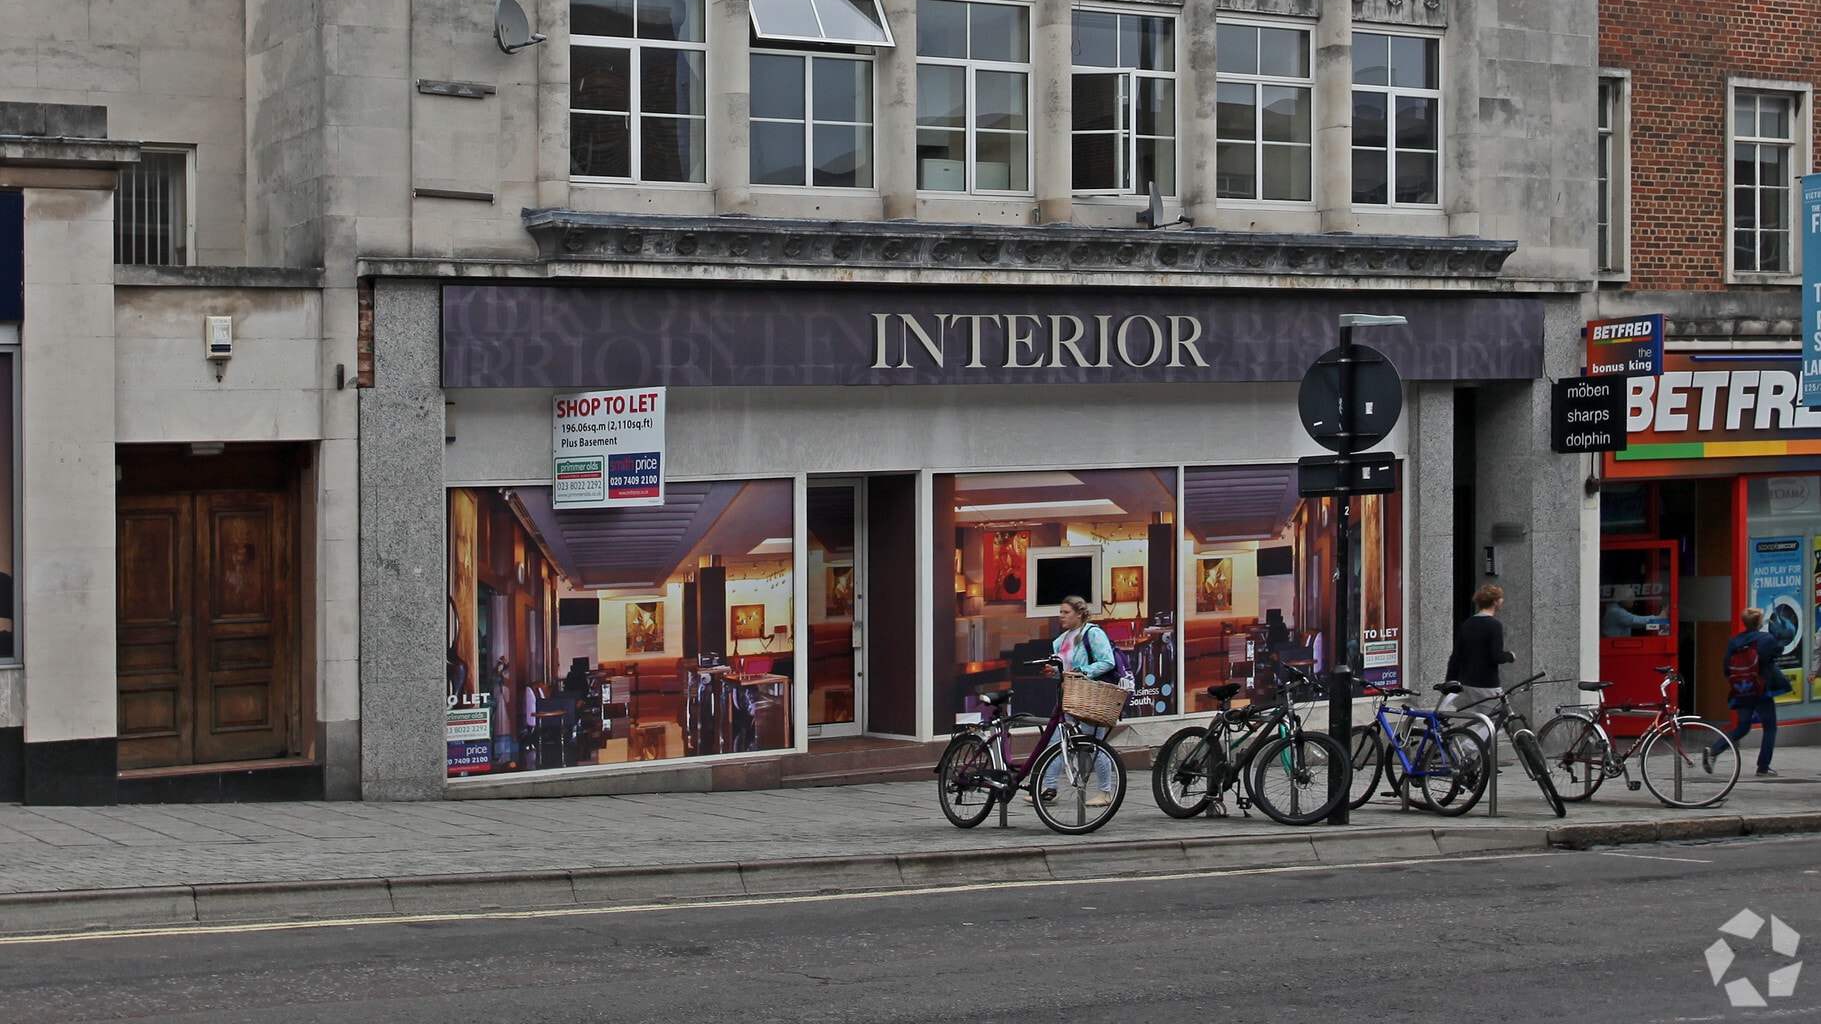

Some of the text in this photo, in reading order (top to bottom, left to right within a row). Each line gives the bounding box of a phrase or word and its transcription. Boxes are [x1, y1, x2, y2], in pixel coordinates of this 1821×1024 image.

[1593, 321, 1652, 340] BETFRED
[870, 313, 1210, 369] INTERIOR
[1638, 348, 1652, 358] the
[1592, 360, 1652, 374] bonus king
[1567, 382, 1610, 398] möben
[556, 393, 658, 419] SHOP TO LET
[1567, 409, 1610, 424] sharps
[562, 418, 653, 433] 196.06sq.m (2,110sq.ft)
[561, 436, 618, 448] Plus Basement
[1566, 432, 1611, 449] dolphin
[560, 462, 586, 473] primmer
[635, 455, 658, 474] price
[557, 480, 602, 491] 023 8022 2292
[610, 475, 658, 486] 020 7409 2100
[1344, 505, 1350, 516] 2
[1754, 564, 1802, 576] AND PLAY FOR
[1363, 627, 1398, 640] TO LET
[1134, 686, 1160, 696] usiness
[447, 692, 490, 706] O LET
[466, 744, 488, 757] price
[454, 758, 470, 766] 7409
[472, 756, 488, 764] 2100
